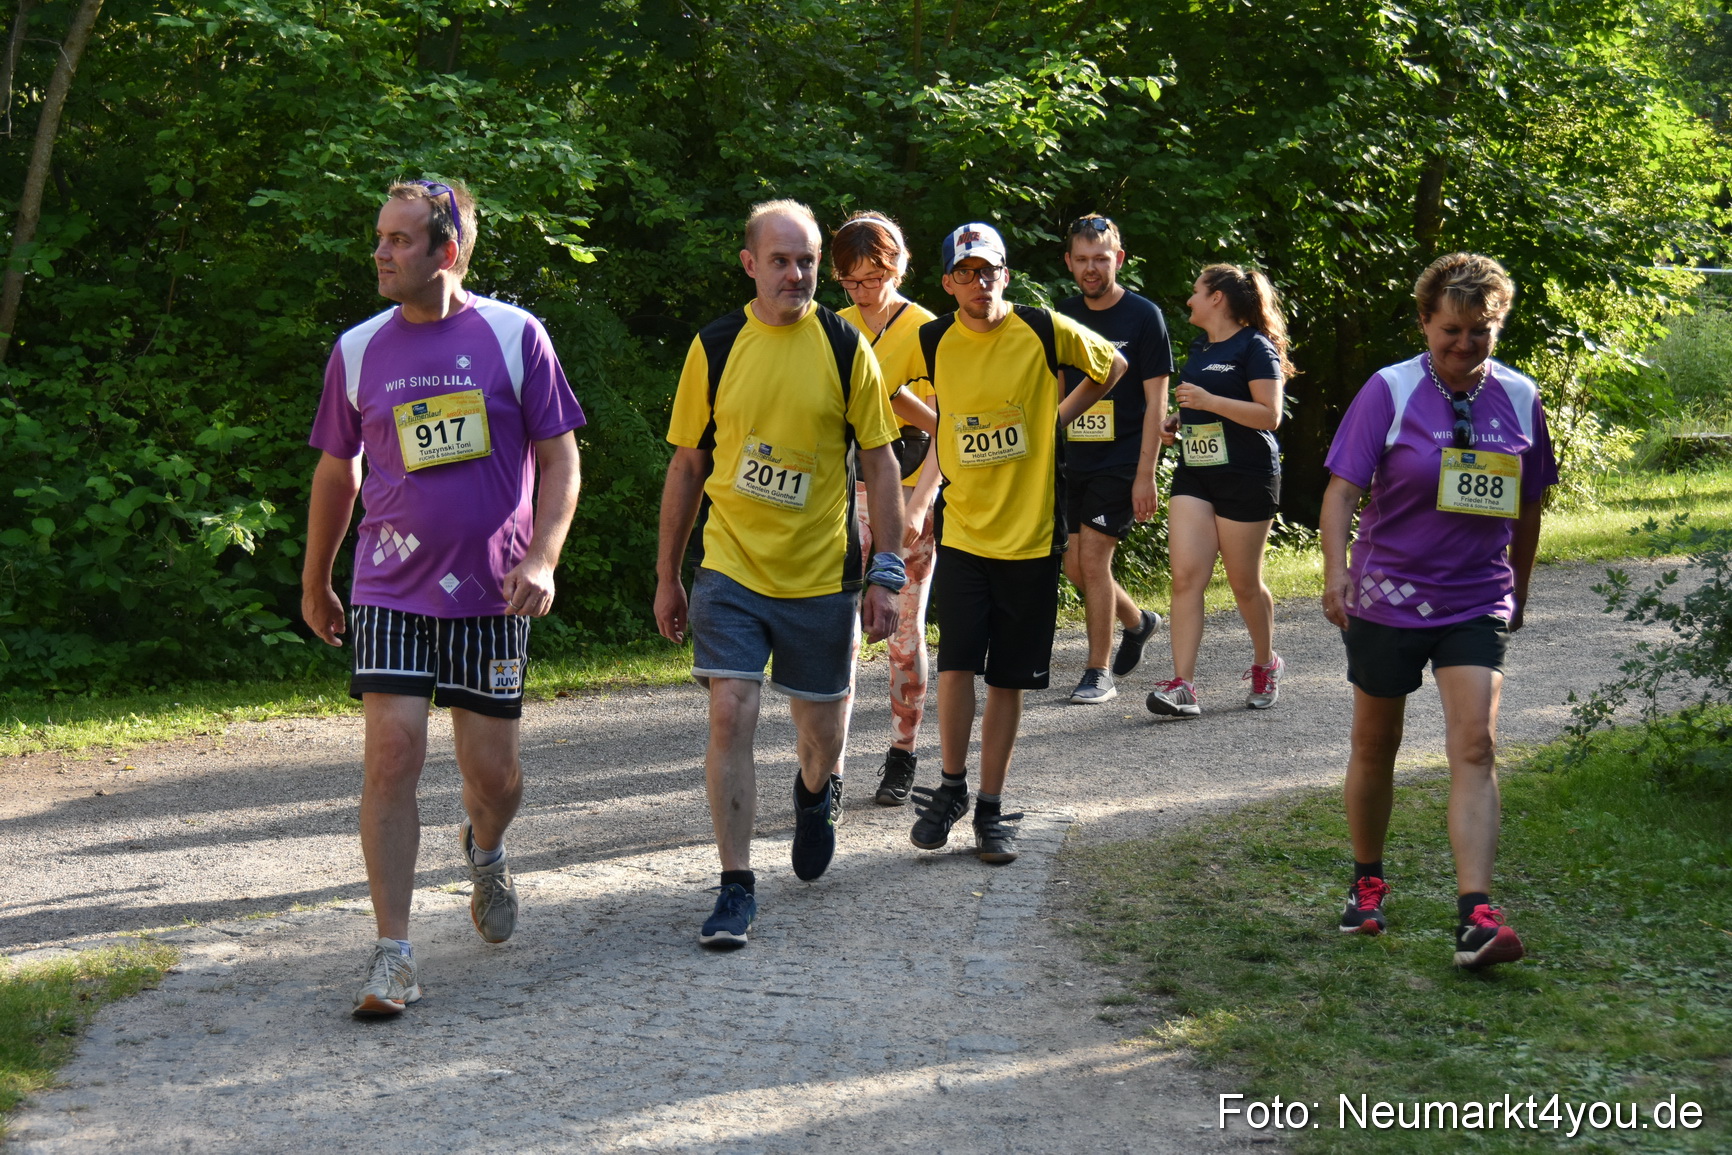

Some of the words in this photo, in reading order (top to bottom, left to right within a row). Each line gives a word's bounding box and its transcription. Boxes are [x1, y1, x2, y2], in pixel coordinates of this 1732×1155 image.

[385, 378, 405, 392] WIR
[409, 376, 440, 387] SIND
[444, 375, 476, 386] LILA.
[1072, 415, 1106, 430] 1453
[415, 417, 465, 448] 917
[962, 427, 1018, 453] 2010
[1433, 431, 1453, 439] WIR
[1482, 433, 1506, 443] LILA.
[420, 444, 454, 456] Tuszynski
[456, 441, 471, 449] Toni
[988, 448, 1014, 457] Christian
[1185, 438, 1219, 454] 1406
[743, 459, 802, 494] 2011
[1457, 473, 1503, 498] 888
[771, 490, 796, 500] Günther
[1485, 498, 1499, 506] Thea
[495, 677, 518, 687] JUVE
